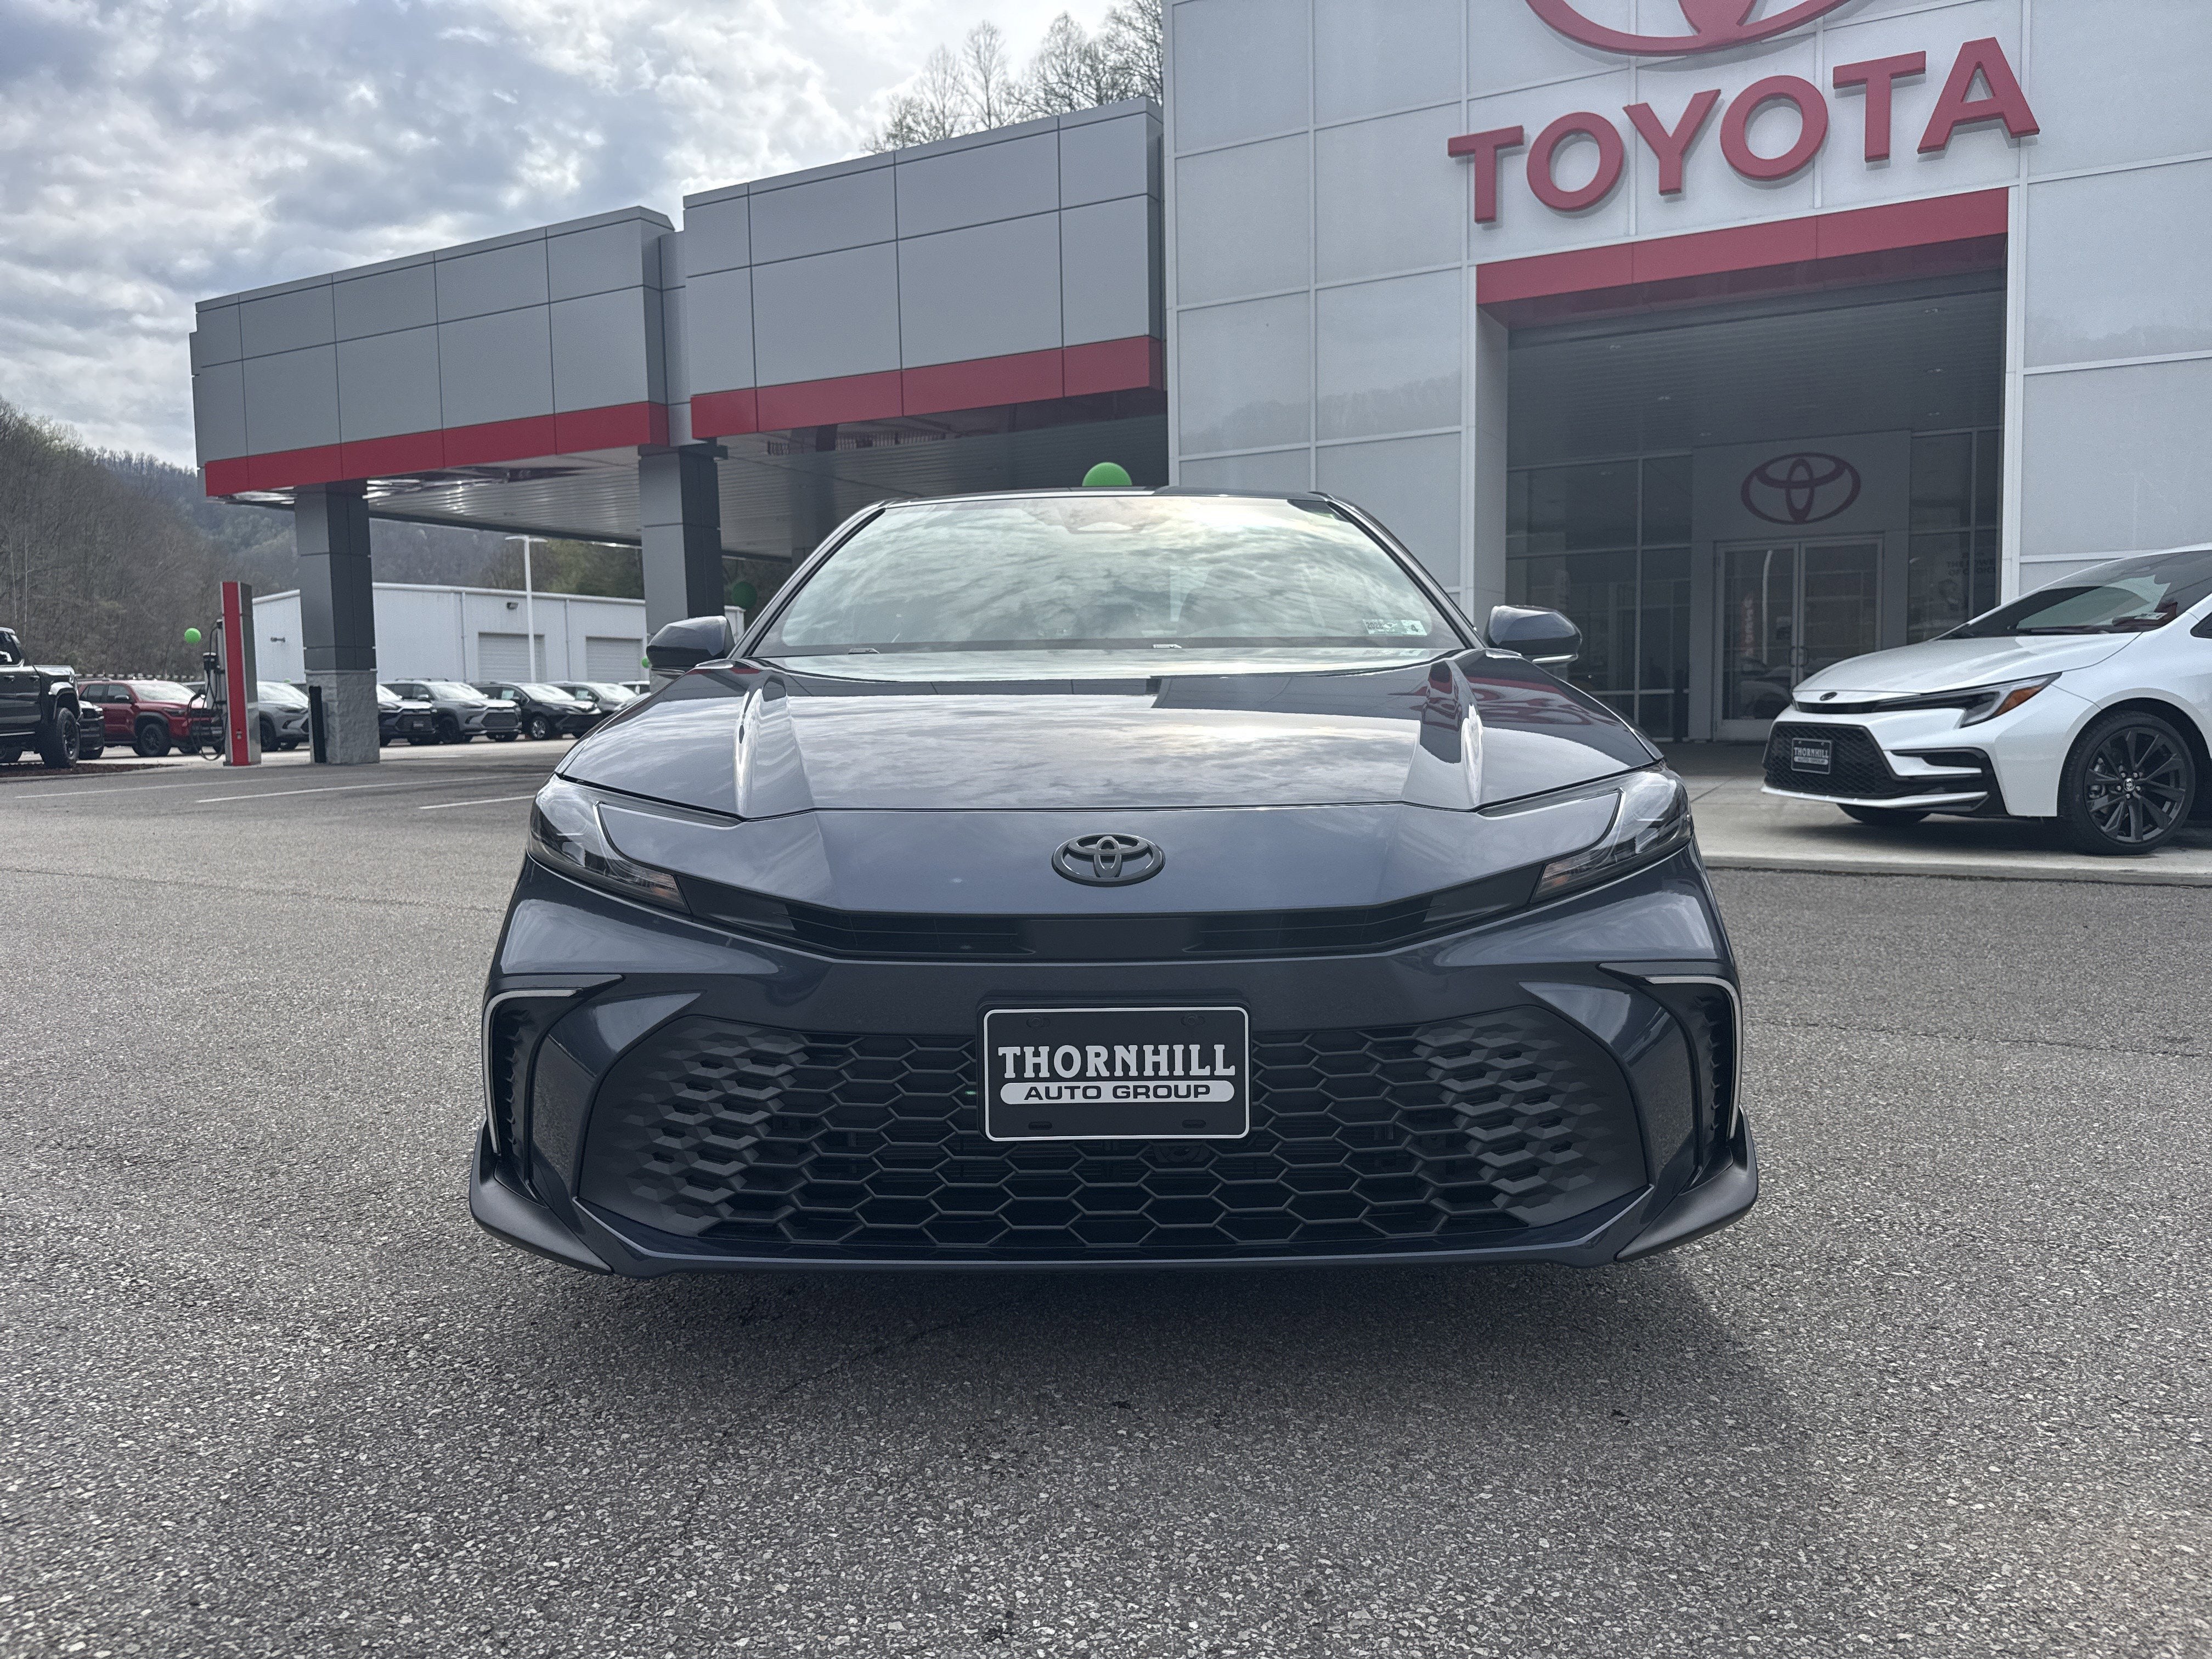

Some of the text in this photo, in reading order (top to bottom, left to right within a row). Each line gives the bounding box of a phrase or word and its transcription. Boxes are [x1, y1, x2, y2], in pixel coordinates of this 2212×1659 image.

[1447, 36, 2040, 224] TOYOTA
[1793, 747, 1829, 758] THORNHILL
[998, 1045, 1235, 1078] THORNHILL
[1024, 1085, 1210, 1100] AUTO GROUP
